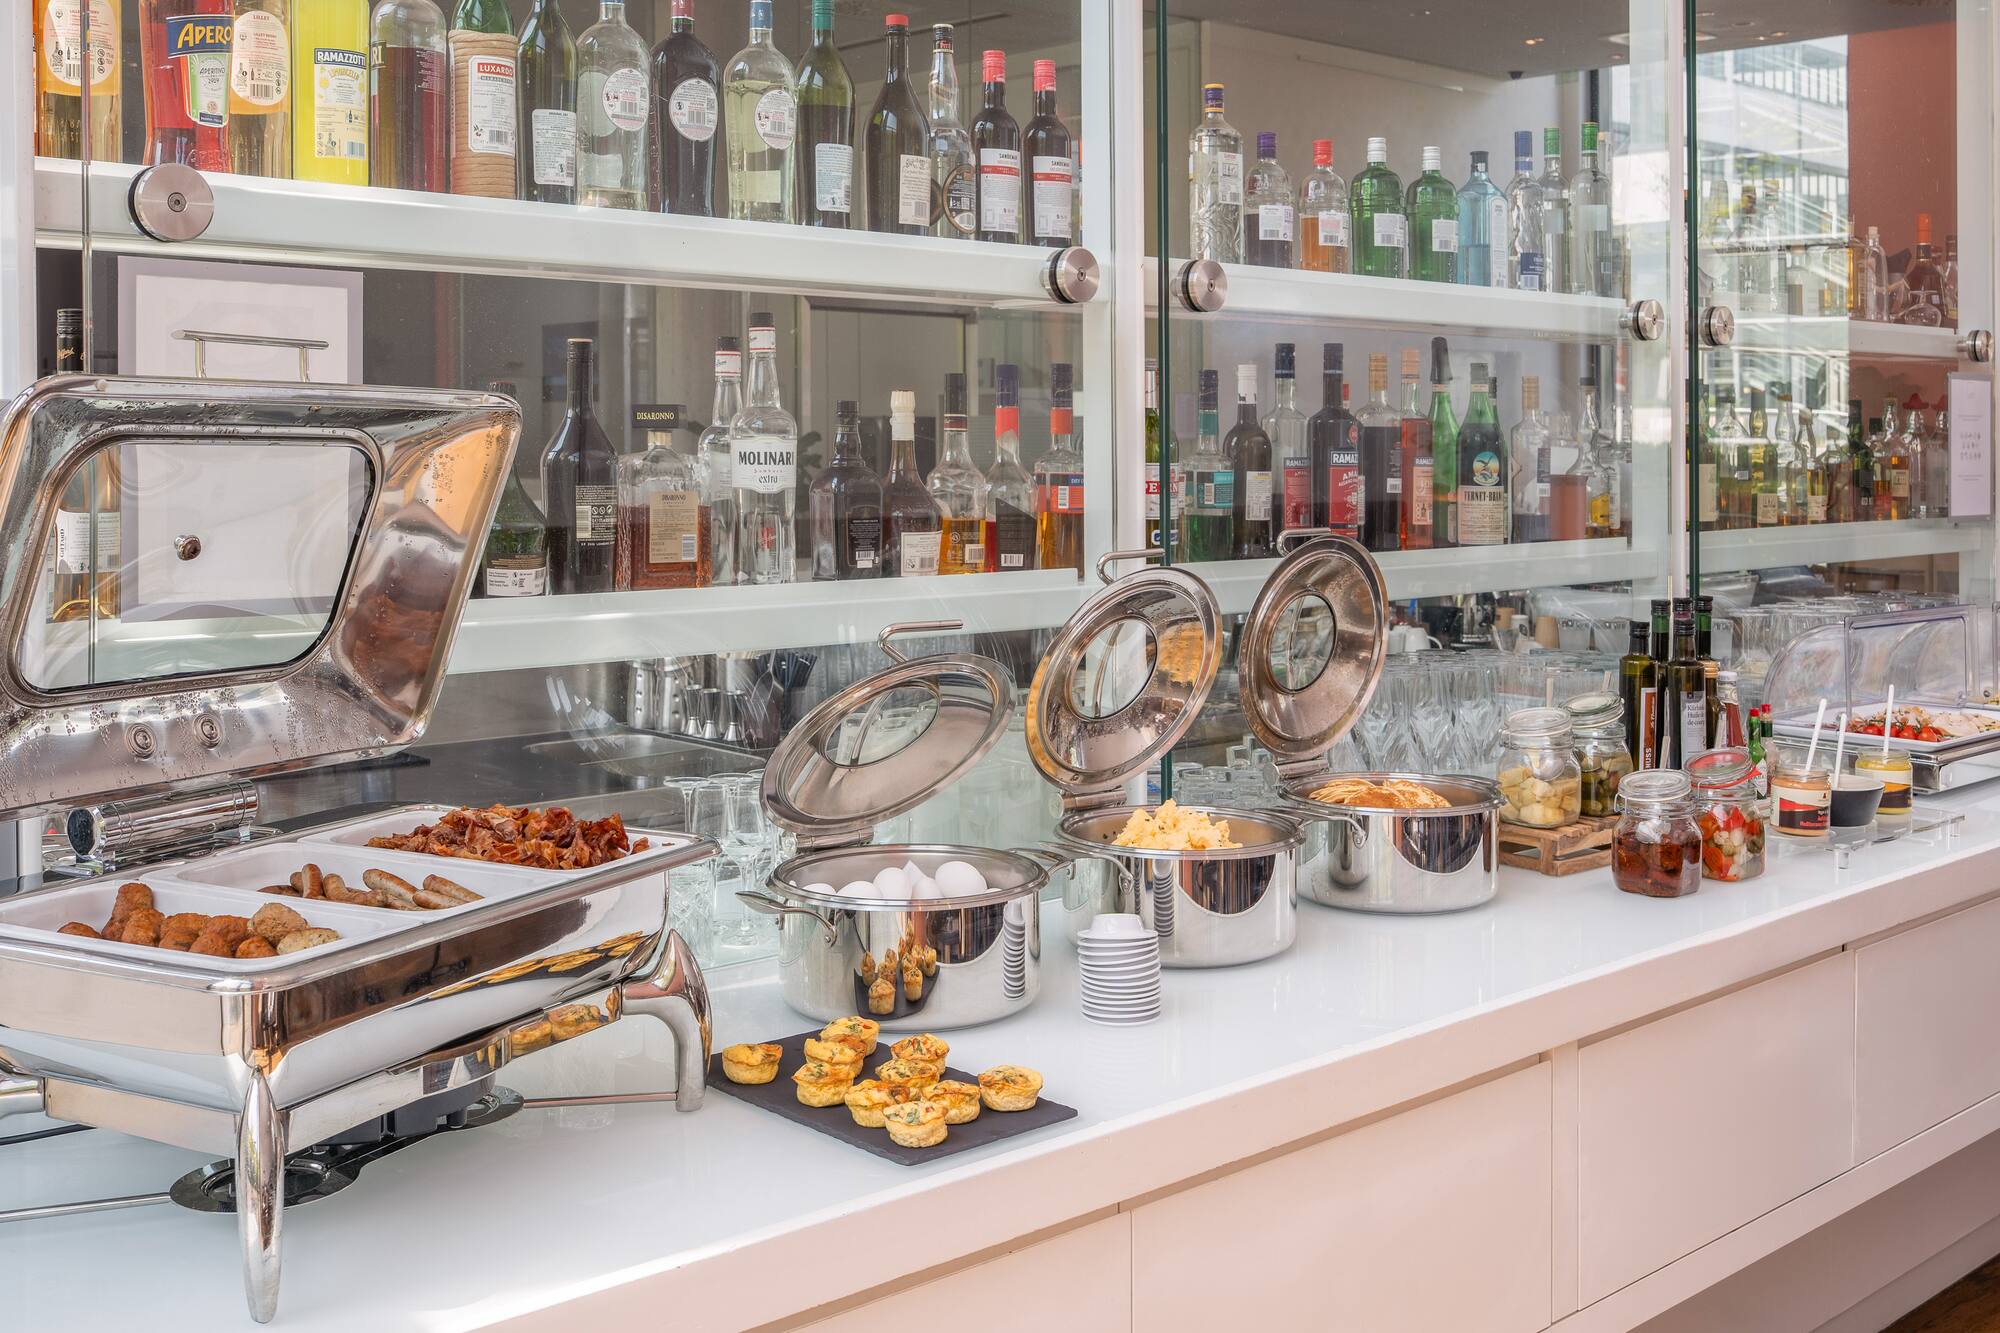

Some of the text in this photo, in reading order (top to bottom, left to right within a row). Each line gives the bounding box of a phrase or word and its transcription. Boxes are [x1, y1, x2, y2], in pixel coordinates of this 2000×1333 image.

[636, 411, 675, 420] DISARONNO
[738, 451, 794, 466] MOLINARI
[1332, 453, 1359, 464] RAMAZ
[758, 474, 778, 484] extra
